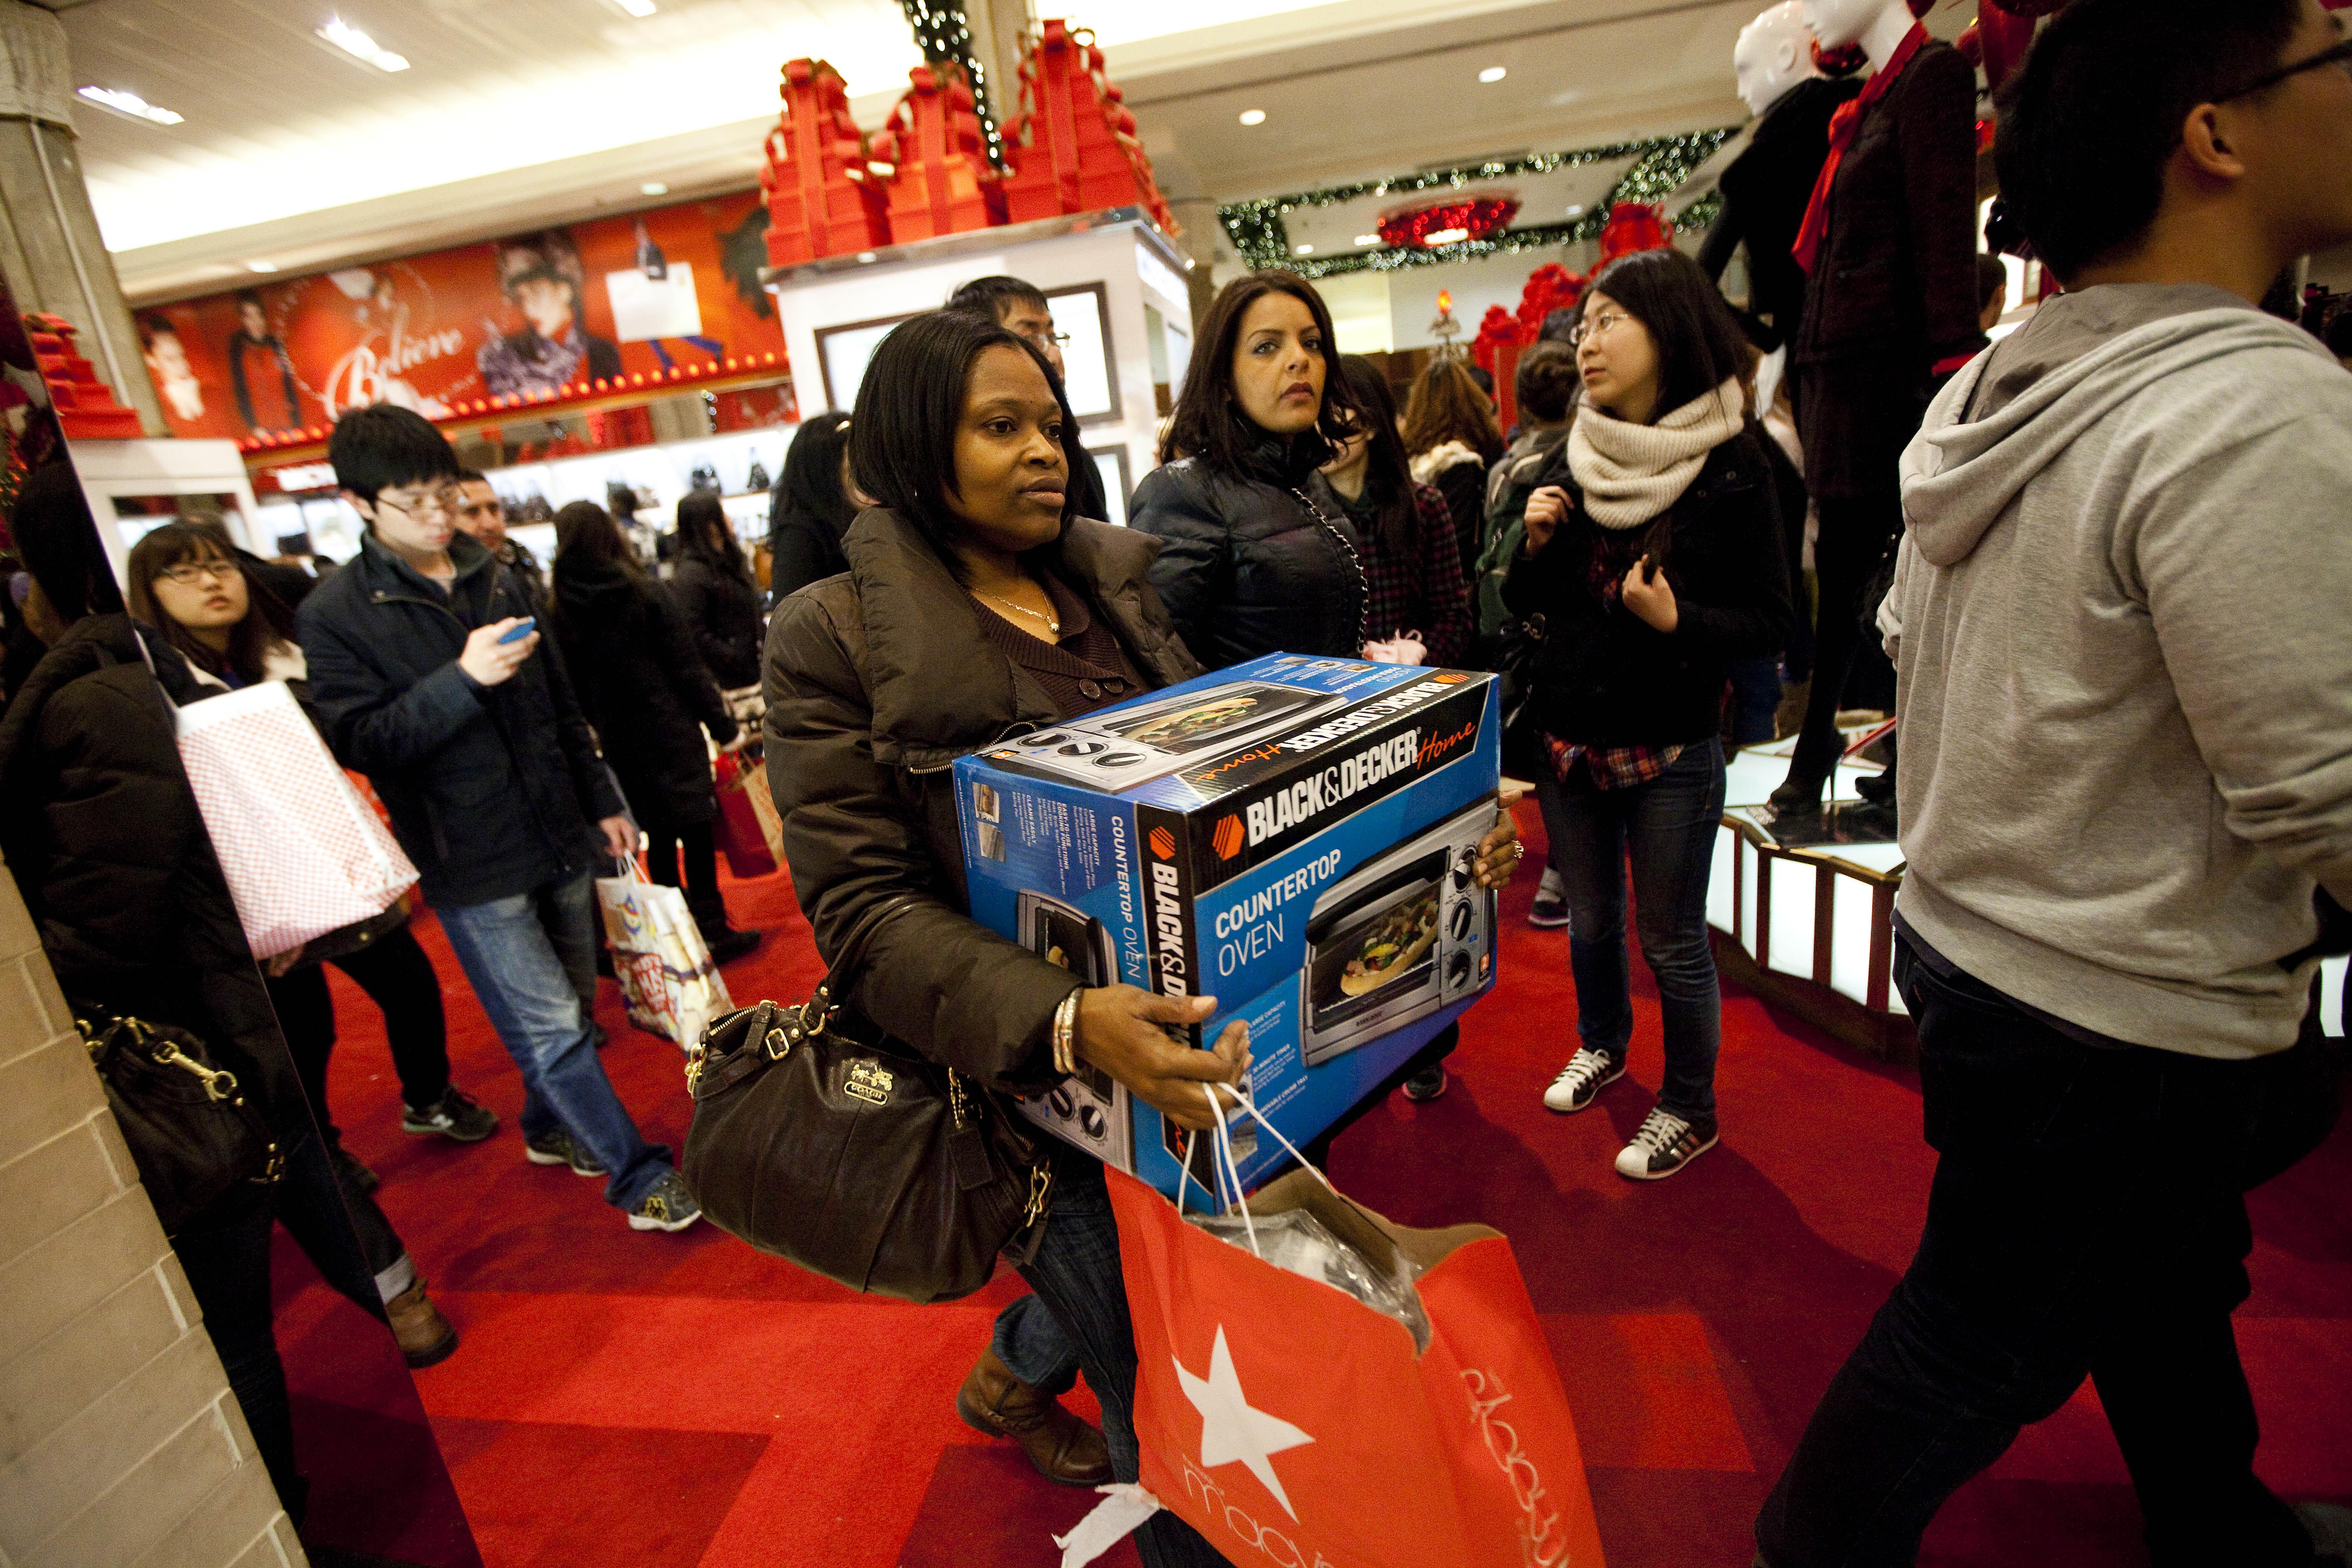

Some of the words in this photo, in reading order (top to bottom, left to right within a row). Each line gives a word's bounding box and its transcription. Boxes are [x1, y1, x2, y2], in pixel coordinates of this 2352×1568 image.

[325, 302, 463, 420] Believe
[1195, 743, 1281, 782] Home
[1279, 682, 1454, 751] BLACK&DECKER
[1246, 729, 1418, 847] BLACK&DECKER
[1415, 722, 1476, 770] Home
[1112, 816, 1133, 923] COUNTERTOP
[1123, 928, 1141, 978] OVEN
[1152, 862, 1187, 996] BLACK&D
[1215, 849, 1341, 939] COUNTERTOP
[1218, 913, 1284, 976] OVEN
